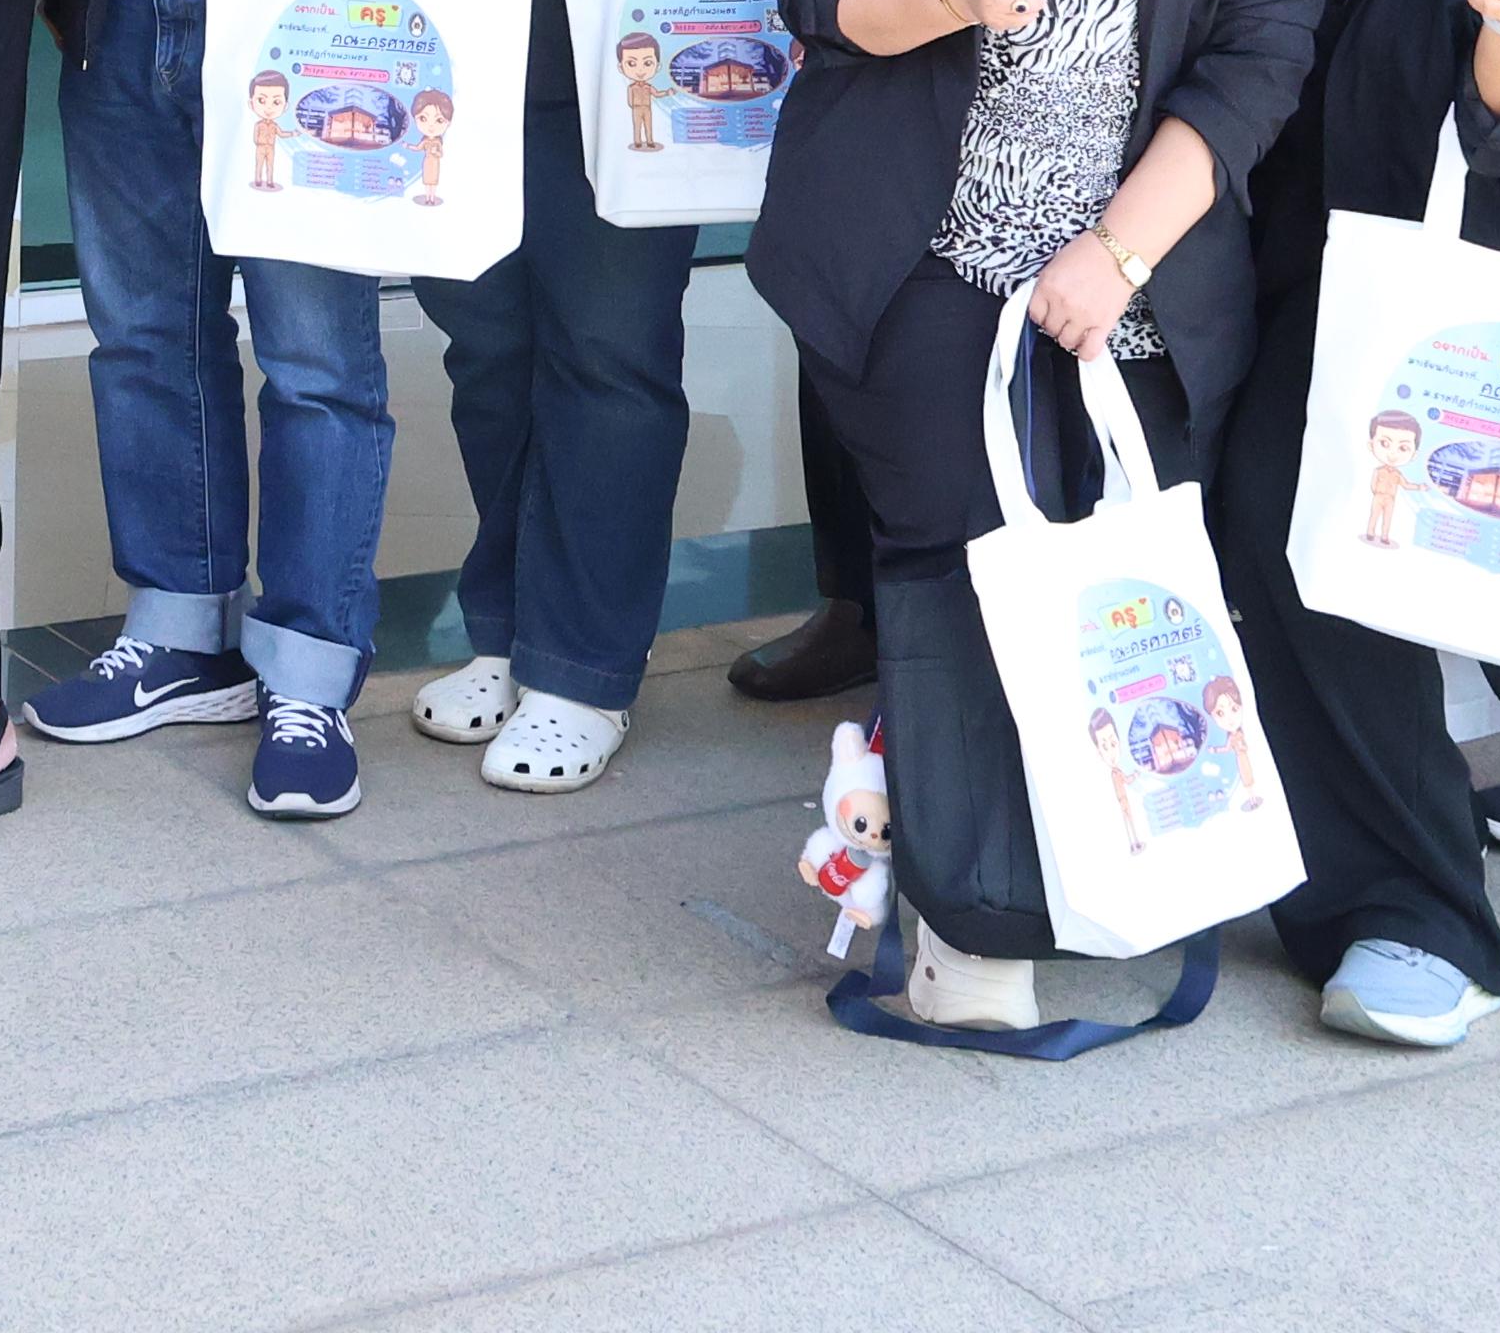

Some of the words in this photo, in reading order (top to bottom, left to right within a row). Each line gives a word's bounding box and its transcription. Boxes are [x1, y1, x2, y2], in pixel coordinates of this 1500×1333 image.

[360, 6, 387, 28] ครู
[331, 34, 438, 54] คณะครุศาสตร์
[1111, 606, 1138, 629] ครู
